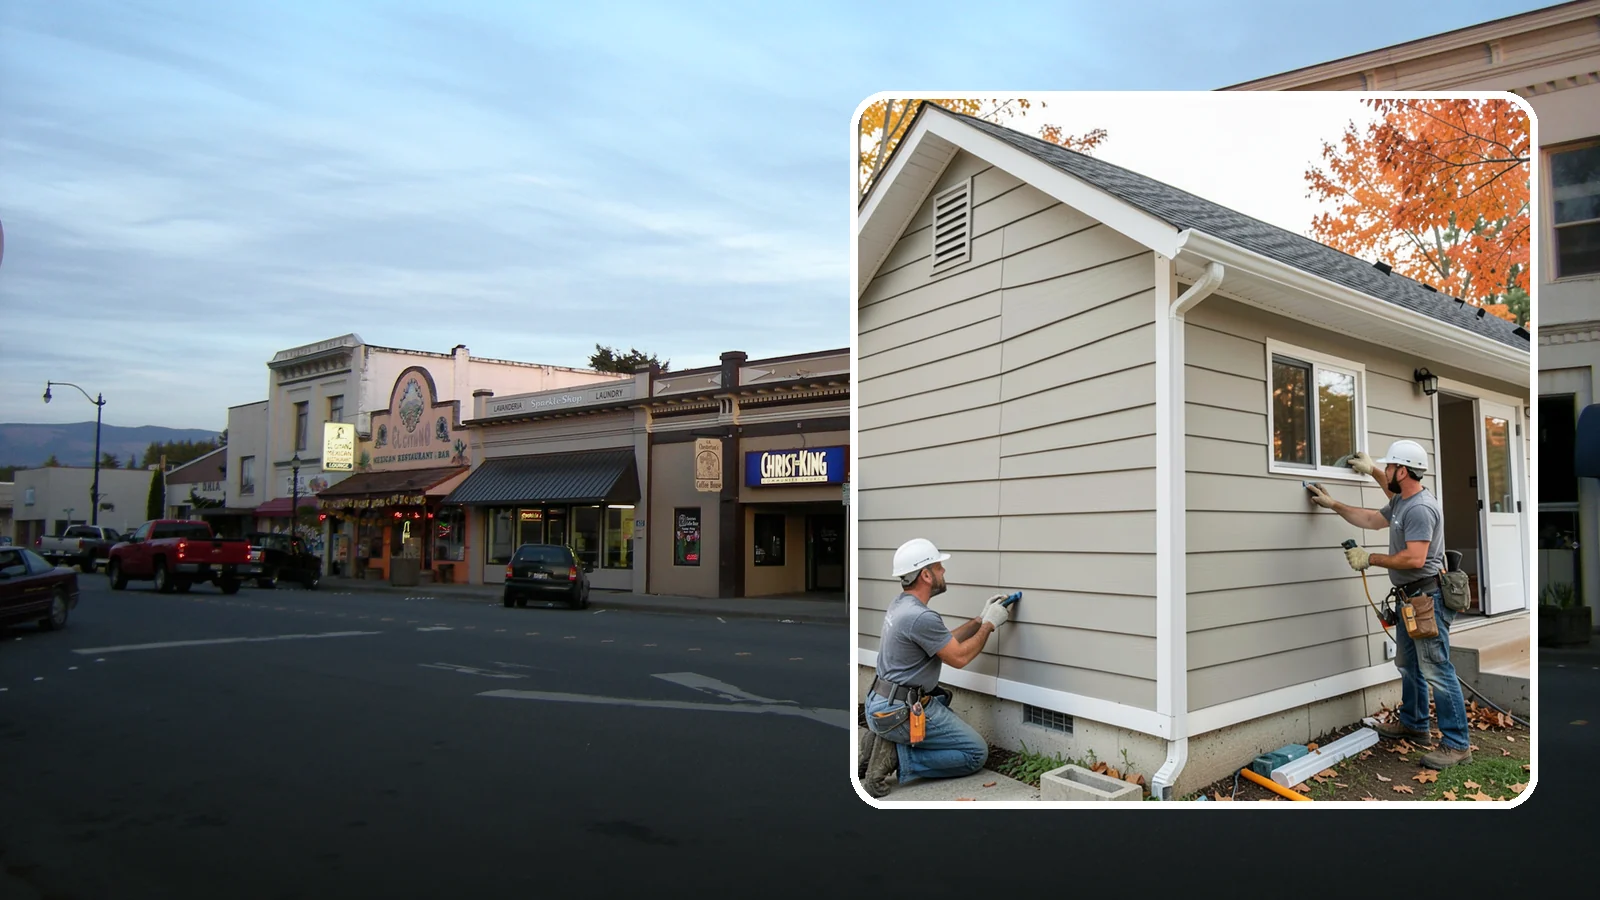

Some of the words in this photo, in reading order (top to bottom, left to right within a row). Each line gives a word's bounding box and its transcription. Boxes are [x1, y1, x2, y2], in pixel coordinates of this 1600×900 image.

[494, 402, 523, 413] LAVANDERIA
[531, 397, 561, 408] Sparkle
[562, 394, 582, 404] Shop
[596, 389, 624, 399] LAUNDRY
[374, 454, 397, 463] MEXICAN
[398, 451, 433, 462] RESTAURANT
[438, 450, 450, 459] BAR
[799, 450, 827, 476] KING
[696, 480, 709, 489] Coffee
[710, 480, 722, 489] House
